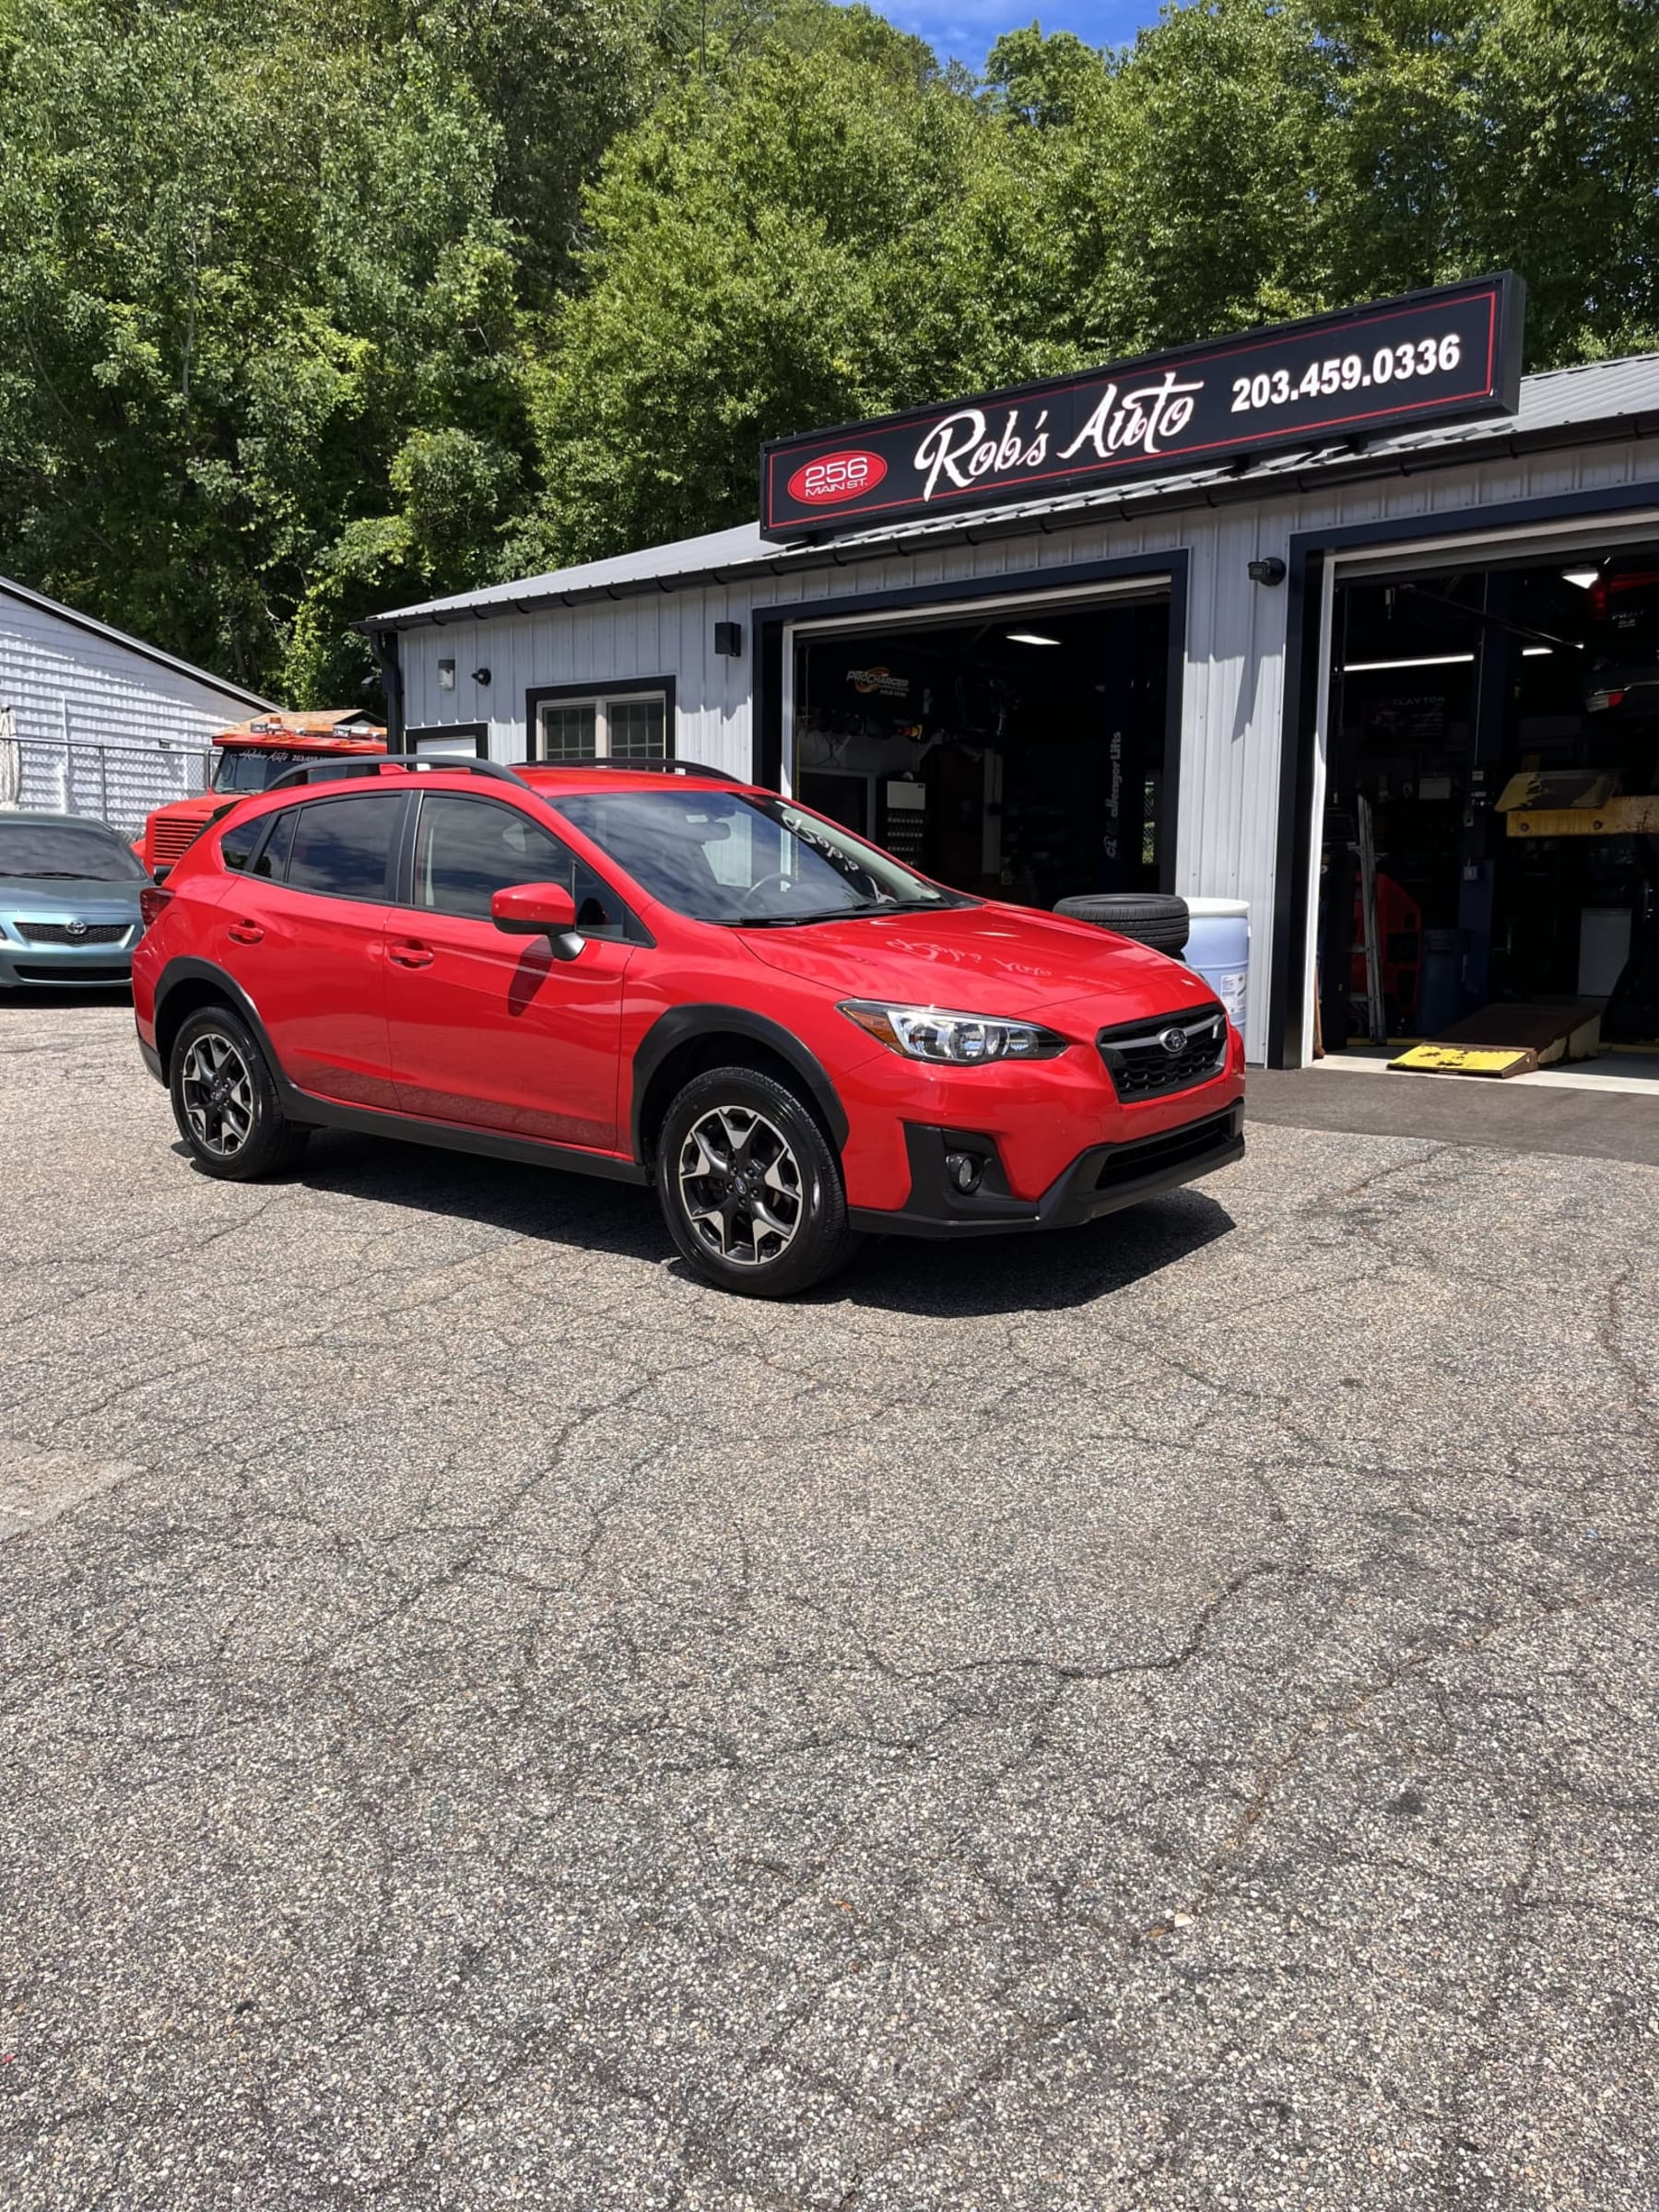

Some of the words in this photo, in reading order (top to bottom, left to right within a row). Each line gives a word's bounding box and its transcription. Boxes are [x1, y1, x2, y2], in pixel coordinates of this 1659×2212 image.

[1231, 334, 1460, 412] 203.459.0336
[913, 408, 1050, 501] Rob's
[1056, 372, 1204, 457] Auto
[805, 457, 868, 485] 256
[806, 481, 845, 497] MAIN
[846, 477, 868, 490] ST.
[1110, 732, 1122, 760] Lifts
